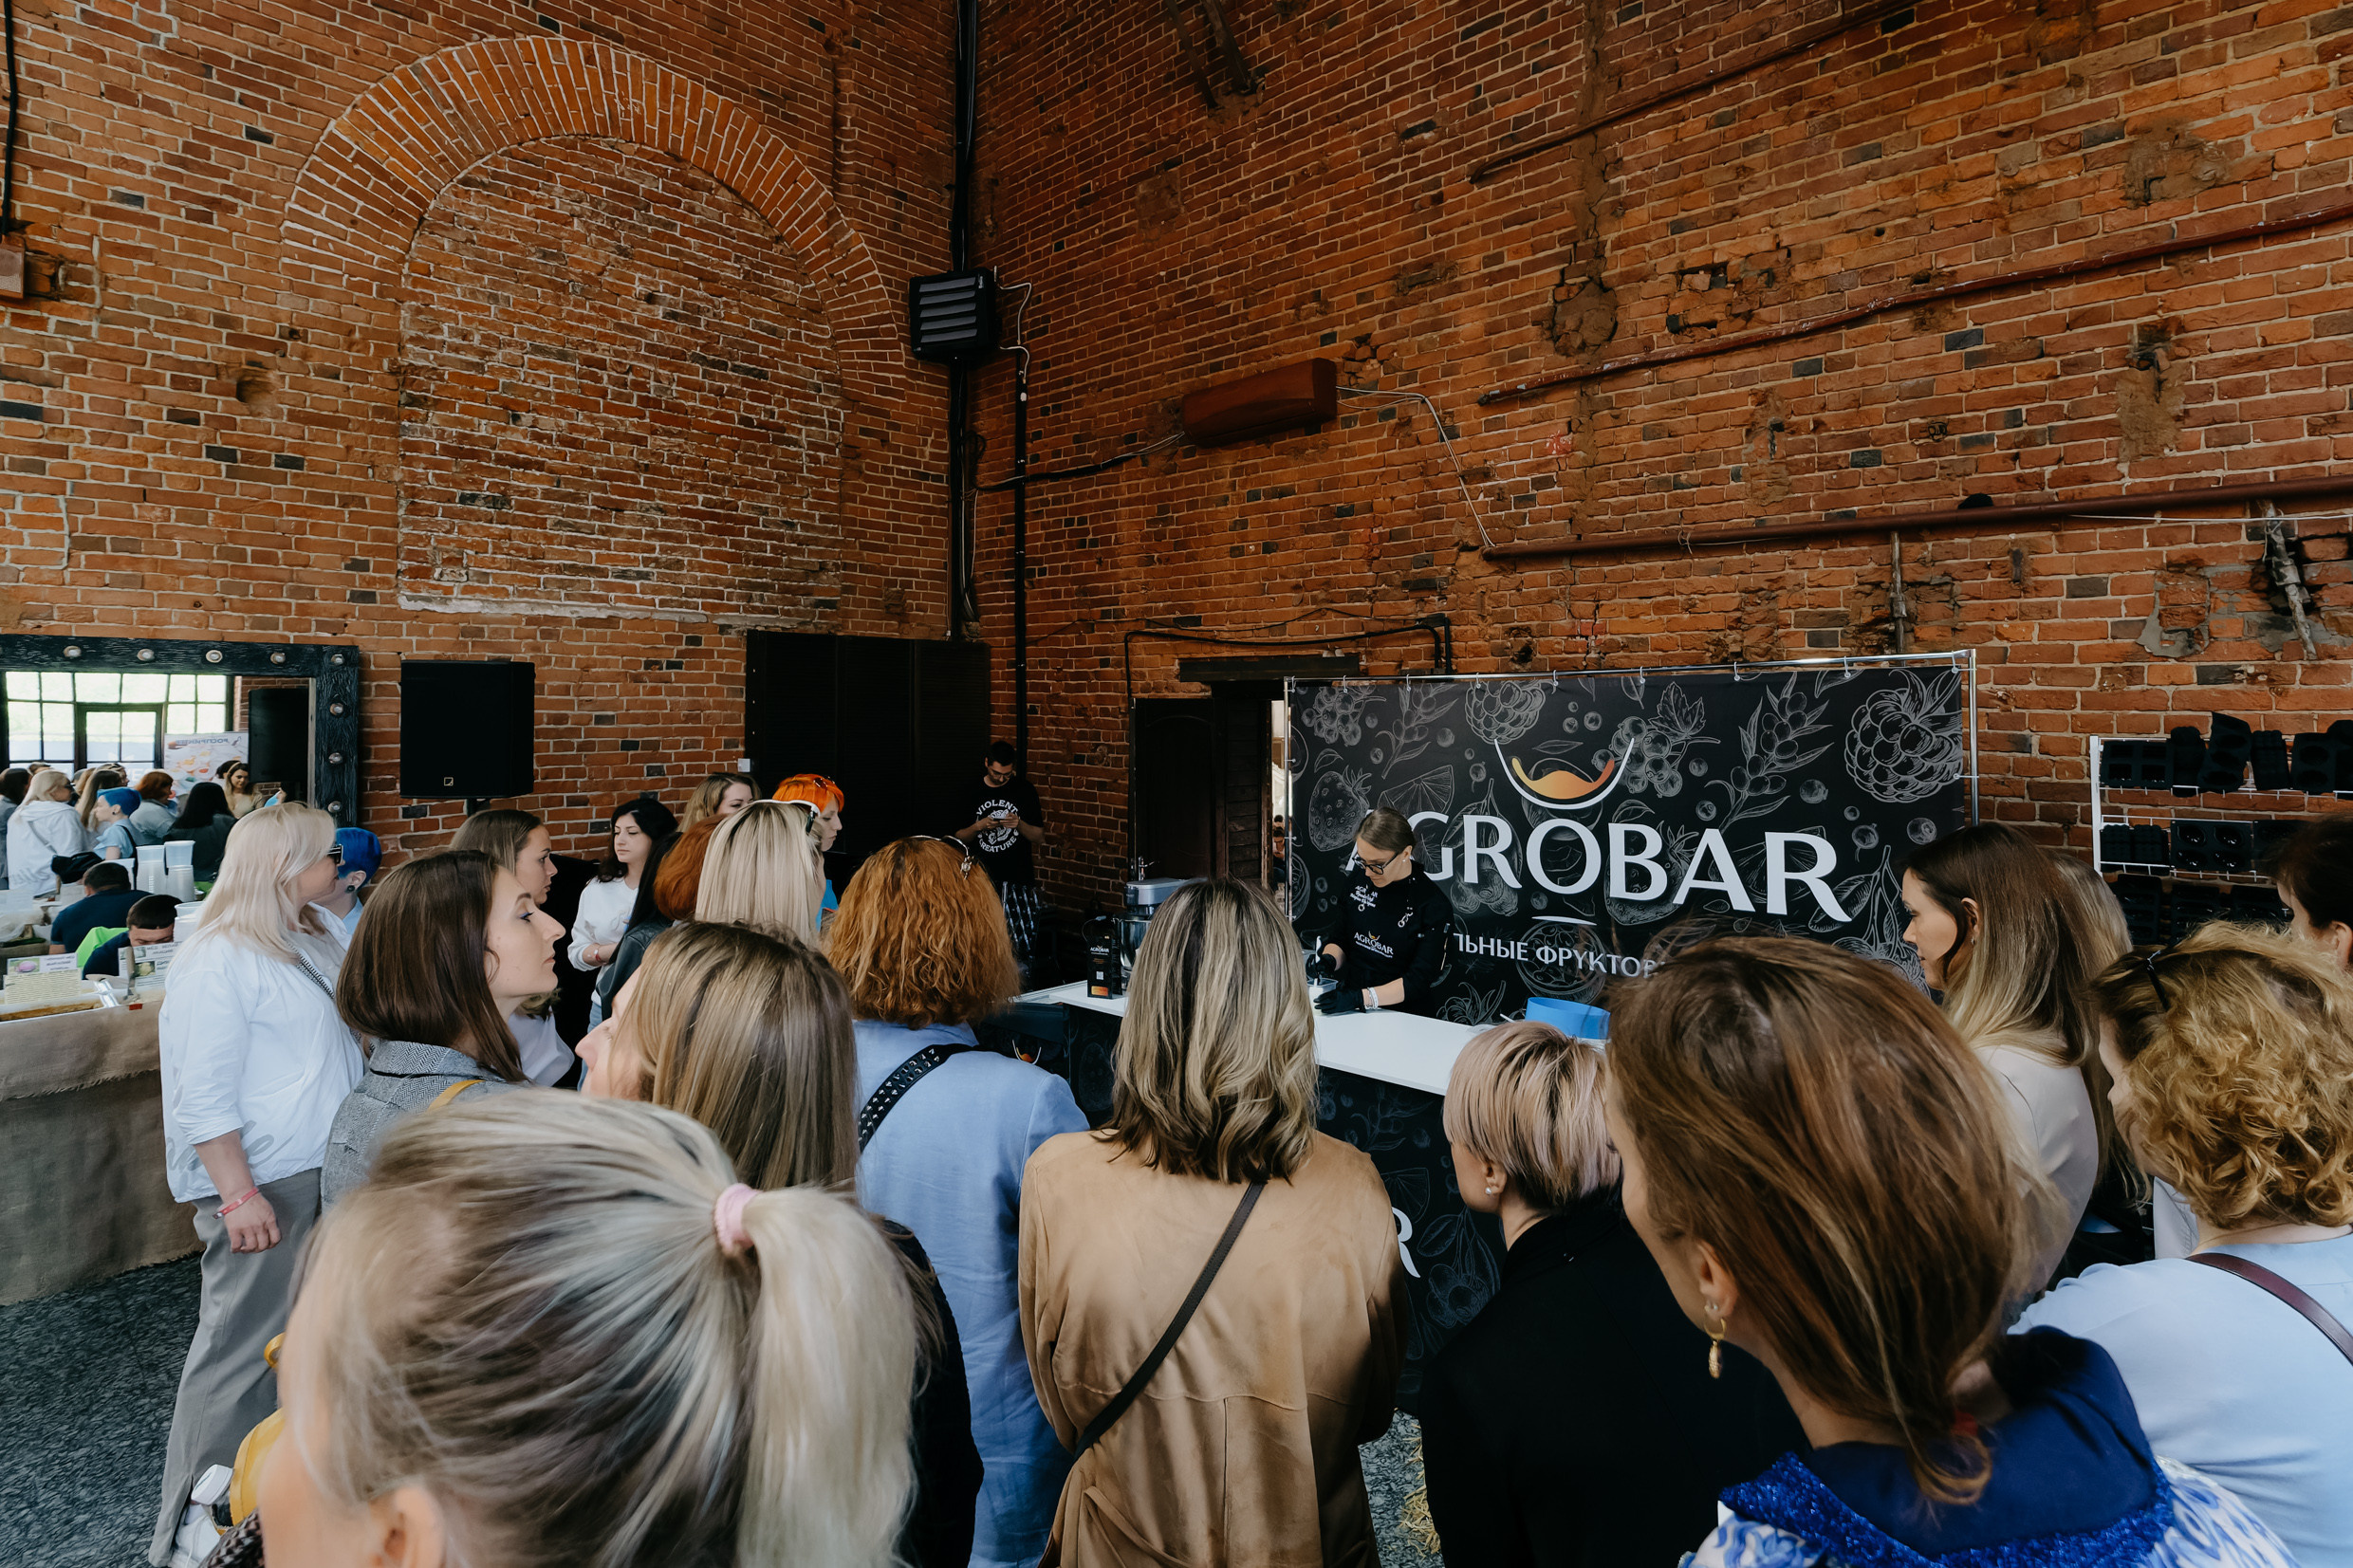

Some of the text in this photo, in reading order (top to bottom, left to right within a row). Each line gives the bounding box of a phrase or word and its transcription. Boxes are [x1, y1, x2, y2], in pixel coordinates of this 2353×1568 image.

[976, 799, 1019, 816] VIOLENT
[978, 836, 1017, 853] CREATURE
[1345, 808, 1852, 923] GROBAR
[1354, 932, 1394, 955] AGROBAR
[1535, 945, 1666, 979] ФРУКТОВ
